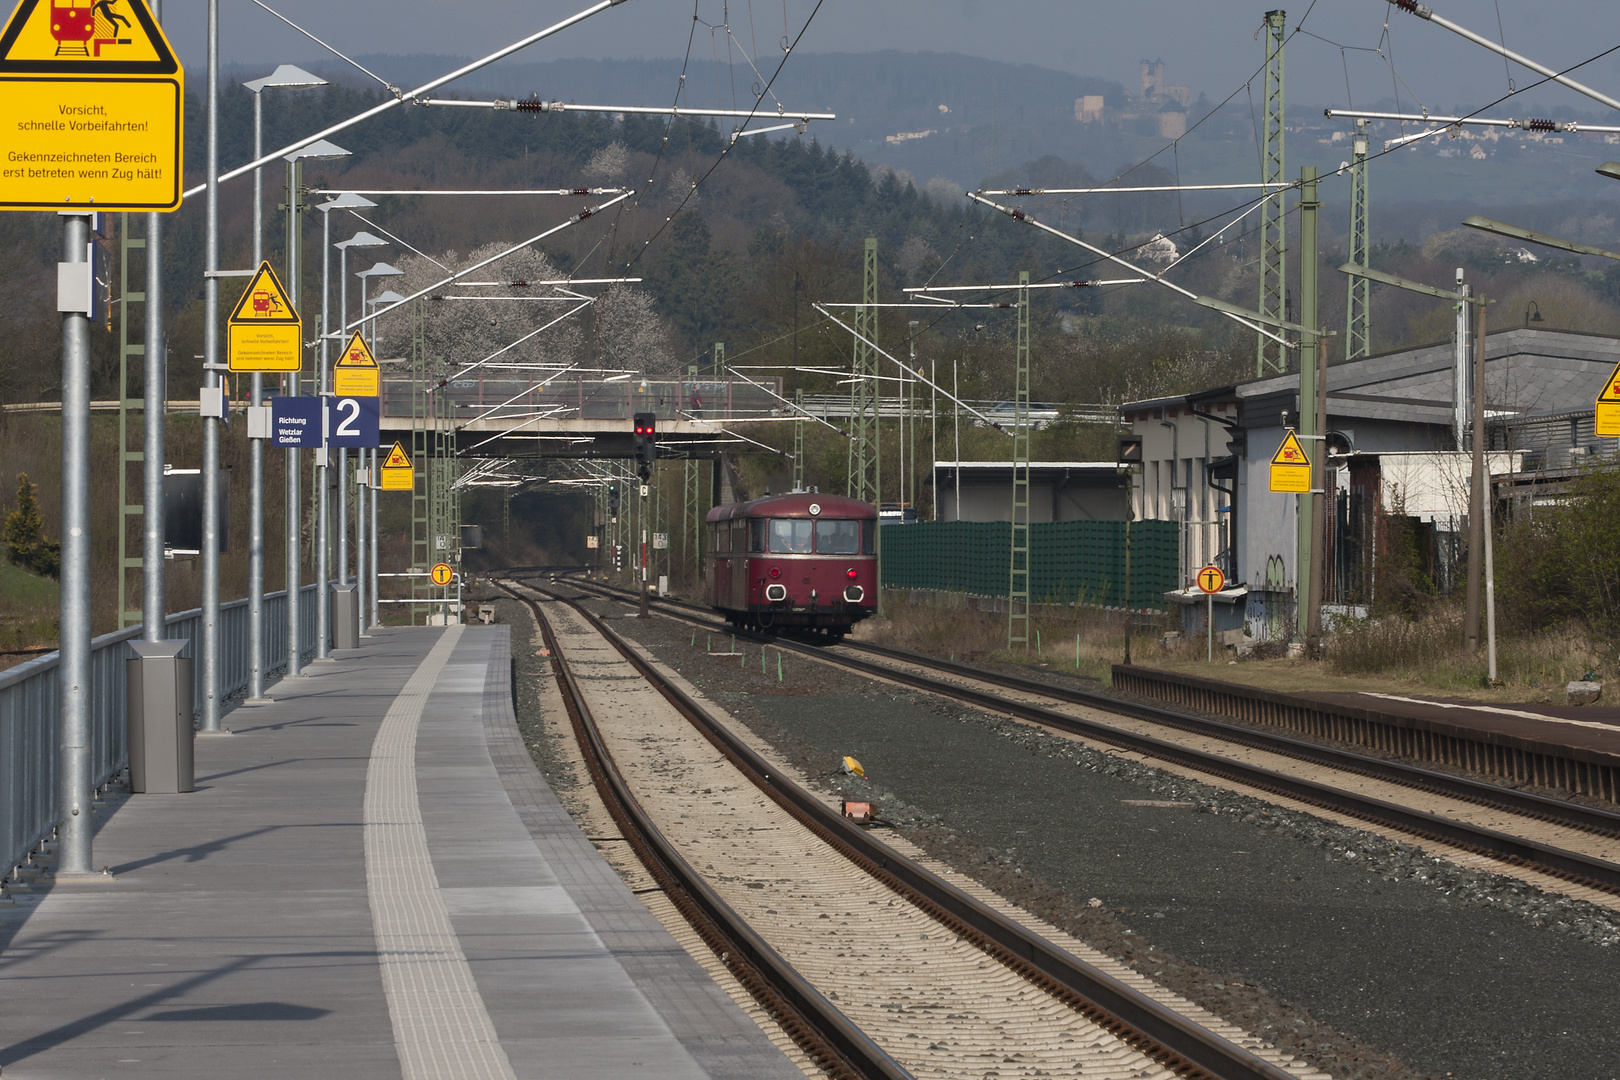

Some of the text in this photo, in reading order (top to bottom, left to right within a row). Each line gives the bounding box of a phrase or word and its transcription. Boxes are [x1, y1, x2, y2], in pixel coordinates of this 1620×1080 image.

[58, 104, 107, 117] Vorsicht,
[18, 120, 148, 132] schnelle Vorbeifahrten!
[8, 151, 157, 163] Gekennzeichneten Bereich
[3, 168, 162, 181] erst betreten wenn Zug hält!
[336, 399, 360, 436] 2
